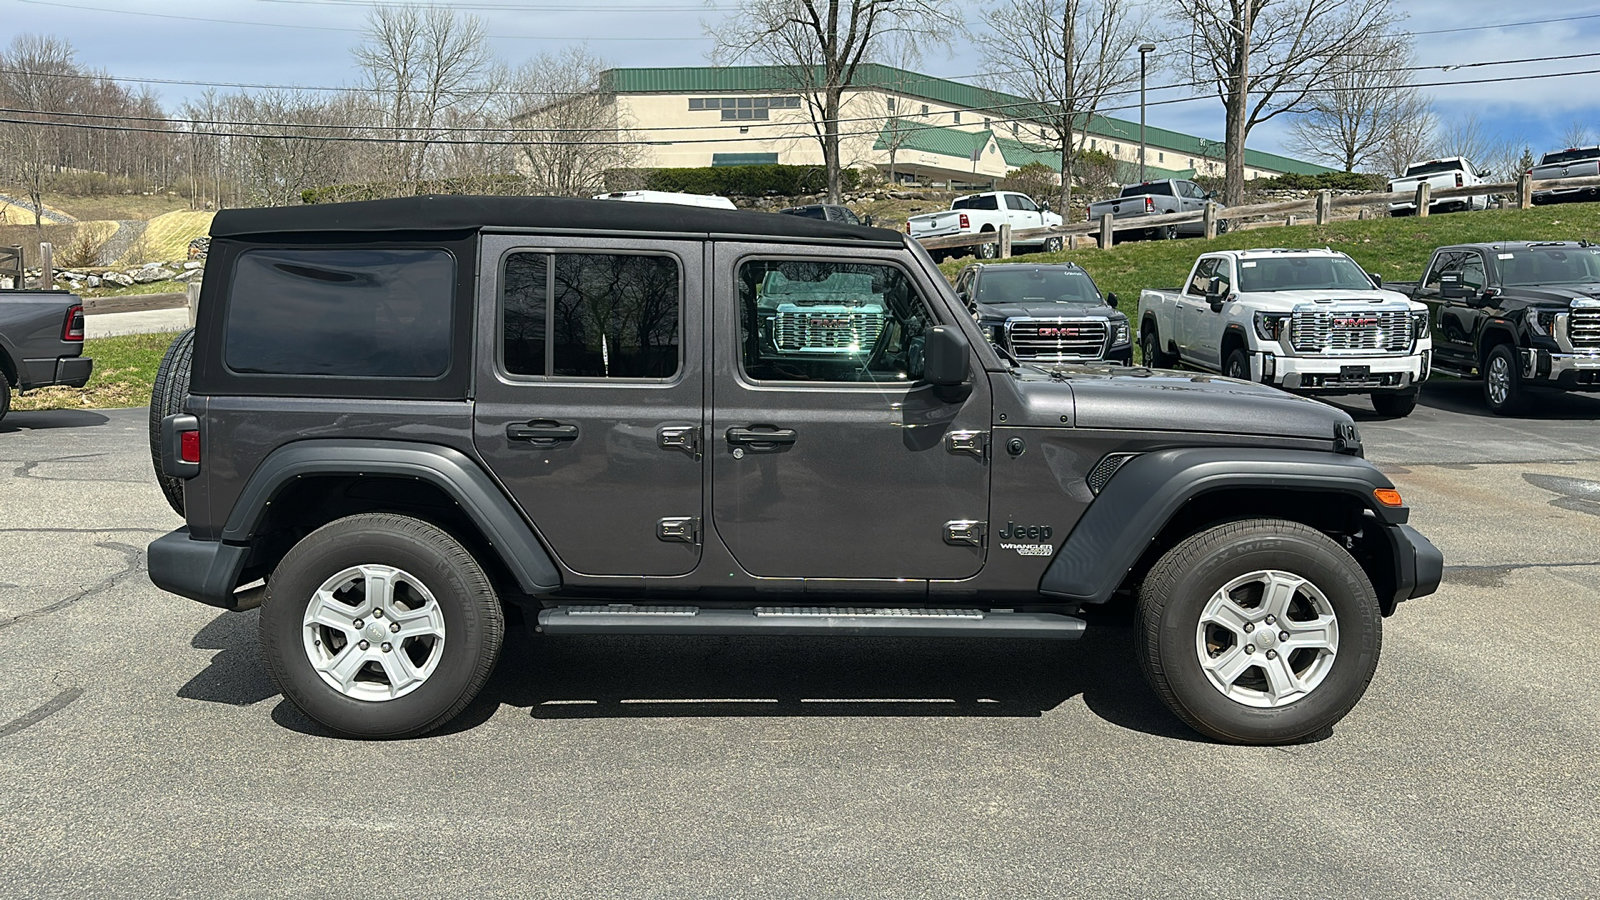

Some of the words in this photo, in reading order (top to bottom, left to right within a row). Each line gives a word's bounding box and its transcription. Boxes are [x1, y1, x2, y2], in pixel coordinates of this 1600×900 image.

[1334, 318, 1378, 328] GMC
[1038, 327, 1079, 337] GMC
[999, 521, 1053, 542] Jeep
